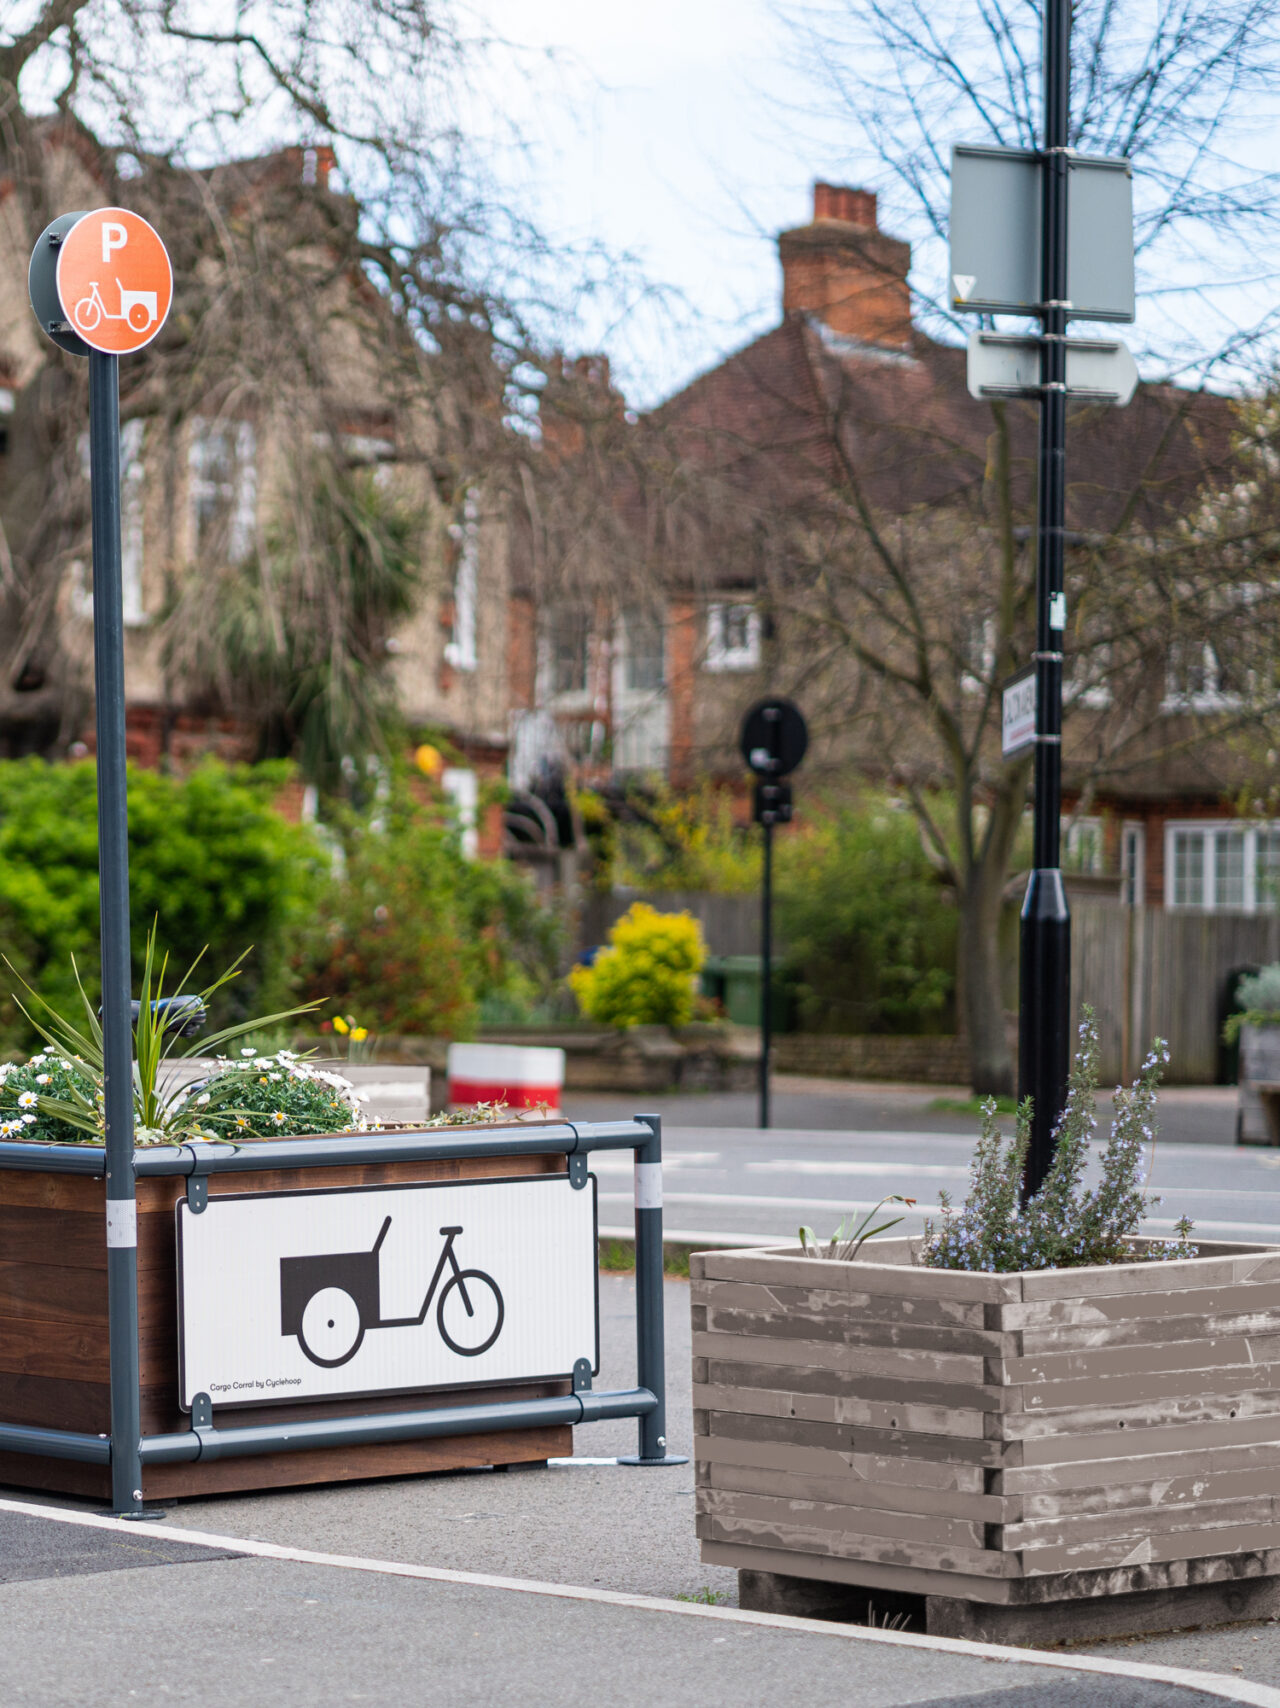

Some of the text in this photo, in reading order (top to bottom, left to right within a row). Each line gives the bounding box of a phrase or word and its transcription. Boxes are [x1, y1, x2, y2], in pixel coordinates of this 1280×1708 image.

[101, 222, 128, 263] P
[210, 1378, 302, 1392] Cargo Corral by Cyclehoop
